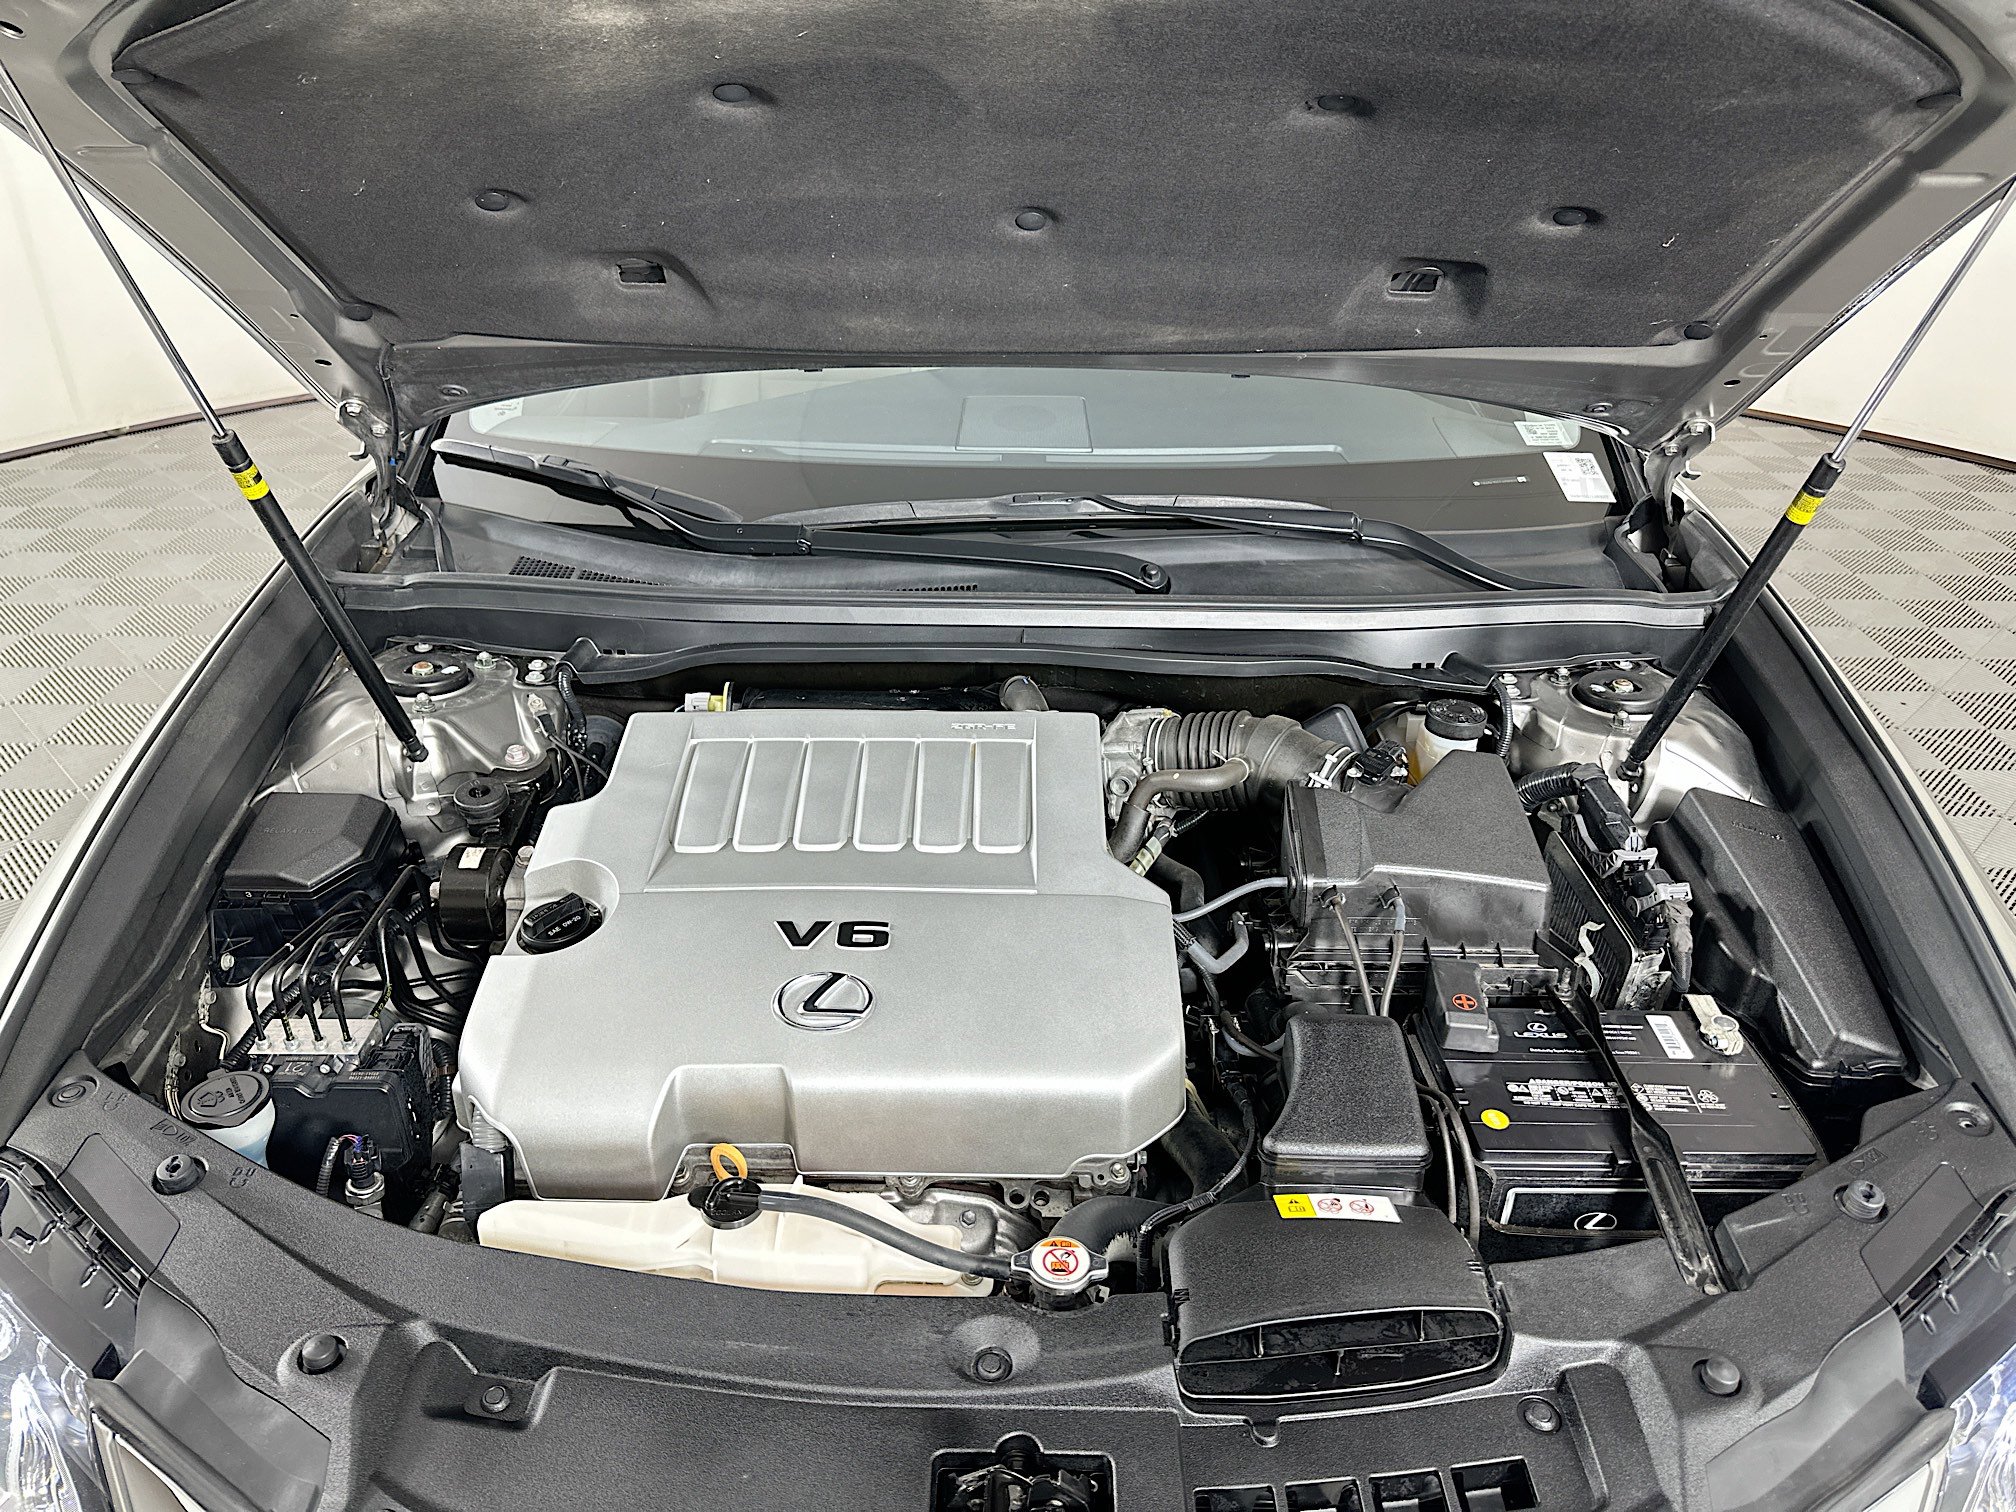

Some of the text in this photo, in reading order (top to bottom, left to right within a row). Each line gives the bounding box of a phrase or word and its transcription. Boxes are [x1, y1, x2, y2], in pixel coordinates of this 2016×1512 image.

[548, 926, 561, 936] SAE
[774, 920, 891, 951] V6
[1513, 1031, 1568, 1039] LEXUS
